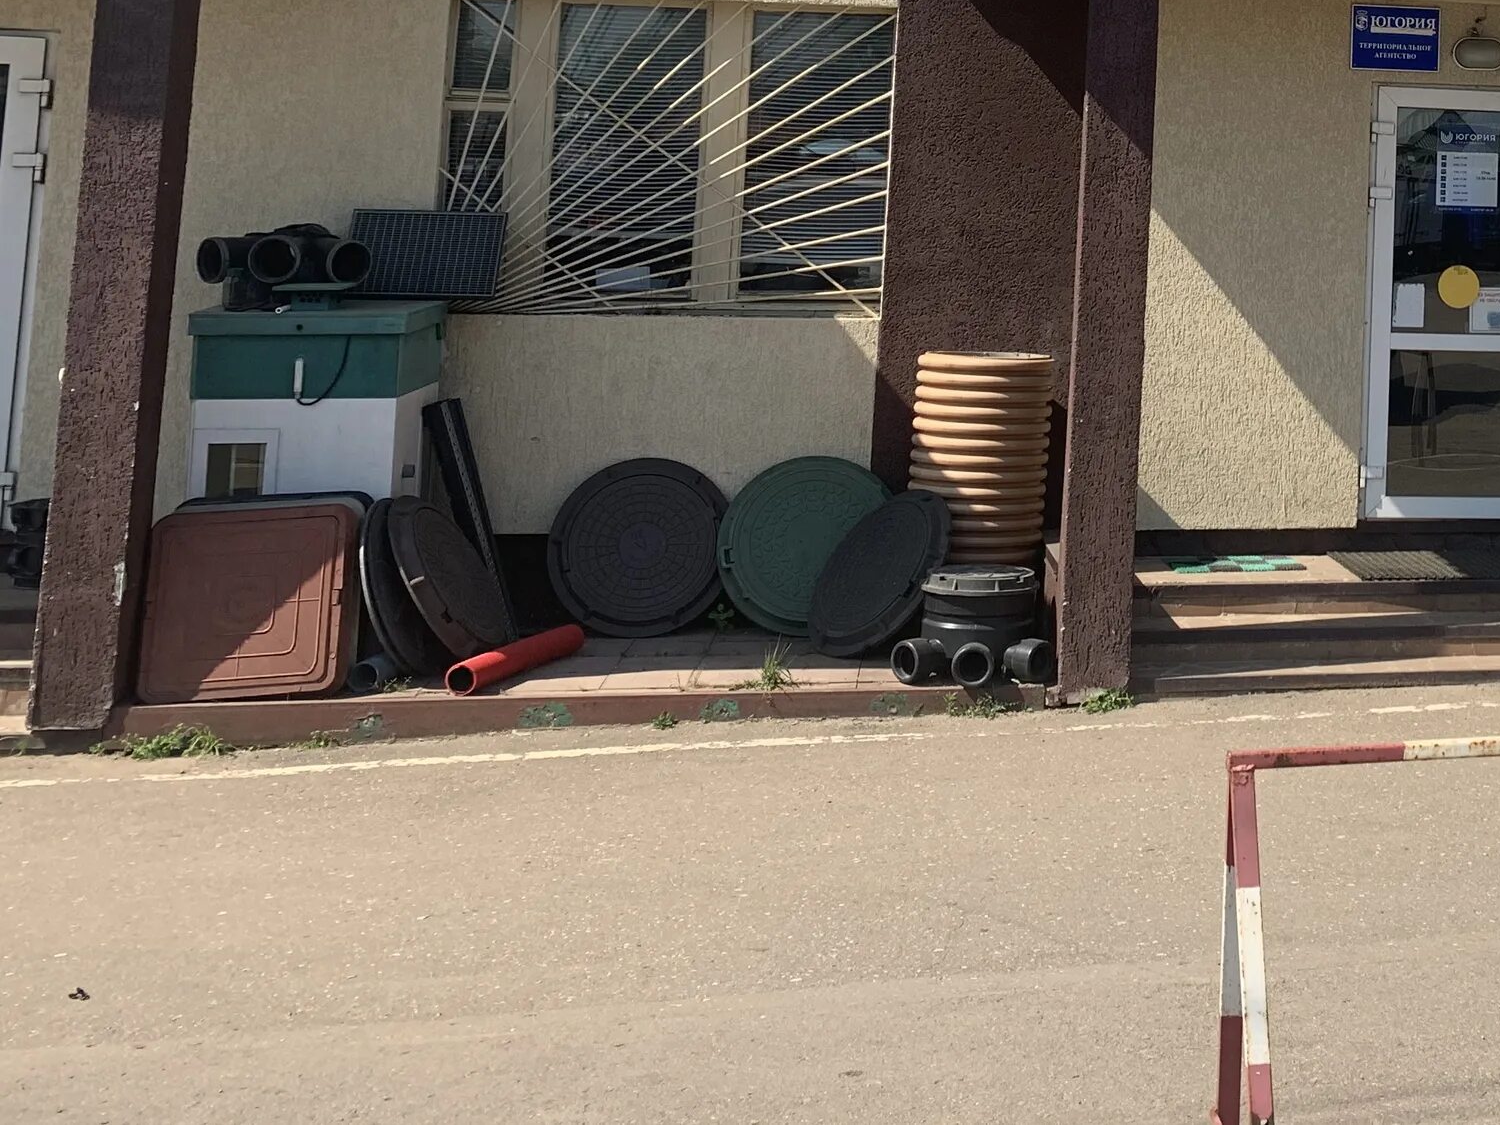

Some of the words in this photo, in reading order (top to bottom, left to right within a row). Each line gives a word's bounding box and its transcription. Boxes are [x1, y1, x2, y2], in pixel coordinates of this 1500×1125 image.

[1370, 15, 1437, 30] ЮГОРИЯ
[1359, 42, 1433, 52] ТЕРРИТОРИАЛЬНОЕ
[1374, 52, 1417, 60] АГЕНТСТВО
[1455, 133, 1496, 142] ЮГОРИЯ
